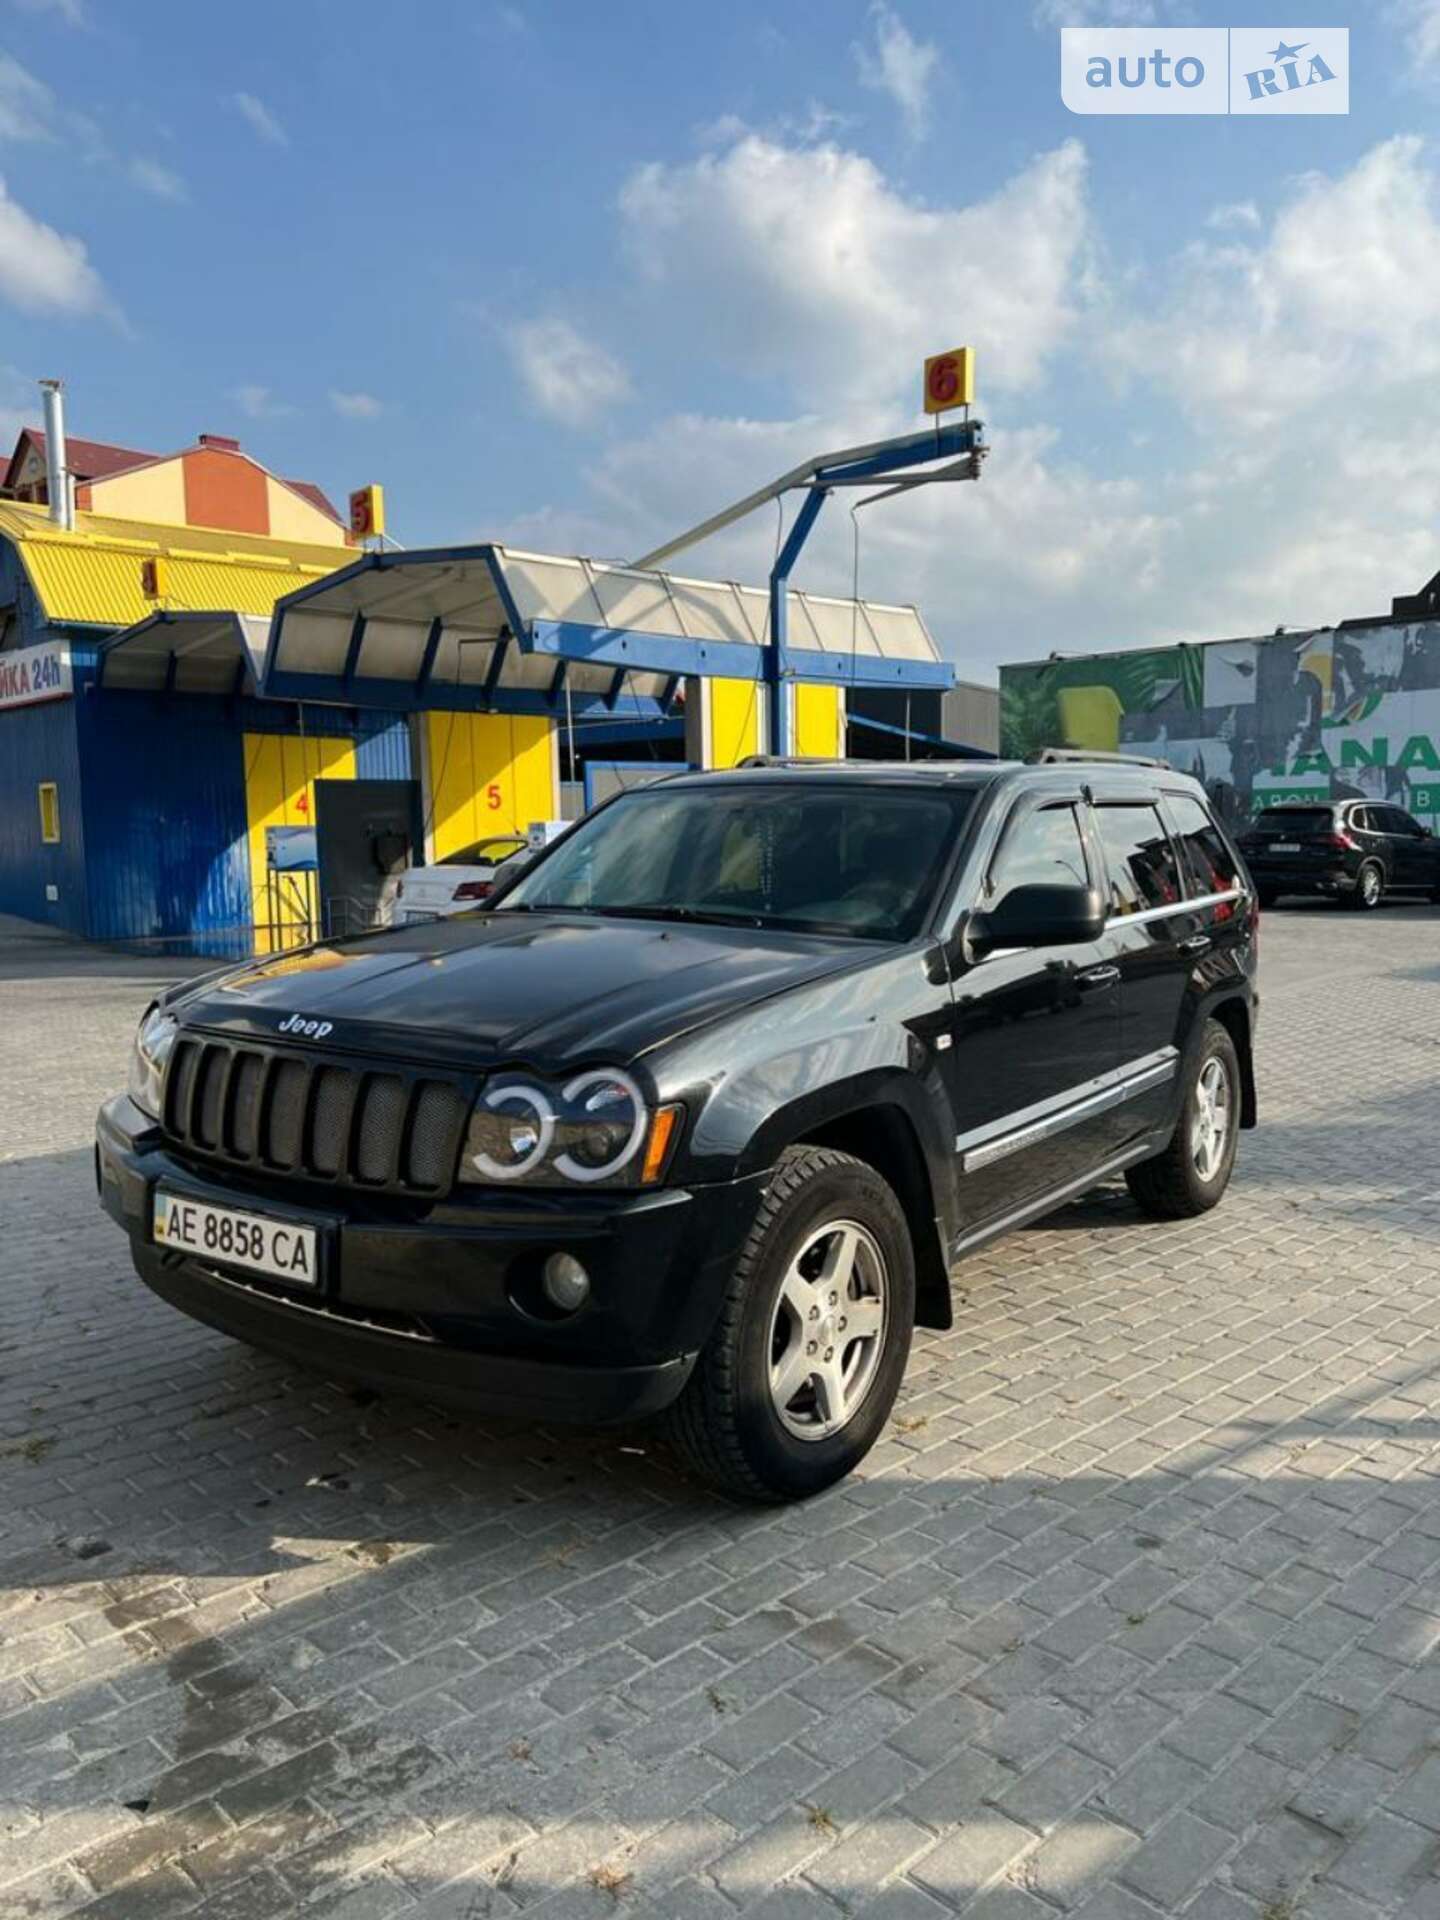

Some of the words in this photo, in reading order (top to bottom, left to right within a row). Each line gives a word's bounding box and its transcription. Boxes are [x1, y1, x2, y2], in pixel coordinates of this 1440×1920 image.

[929, 356, 961, 401] 6
[352, 491, 371, 532] 5
[32, 653, 60, 690] 24h
[295, 792, 309, 814] 4
[488, 784, 502, 811] 5
[278, 1013, 333, 1039] Jeep
[167, 1203, 197, 1244] AE
[203, 1213, 264, 1260] 8858
[271, 1230, 308, 1273] CA
